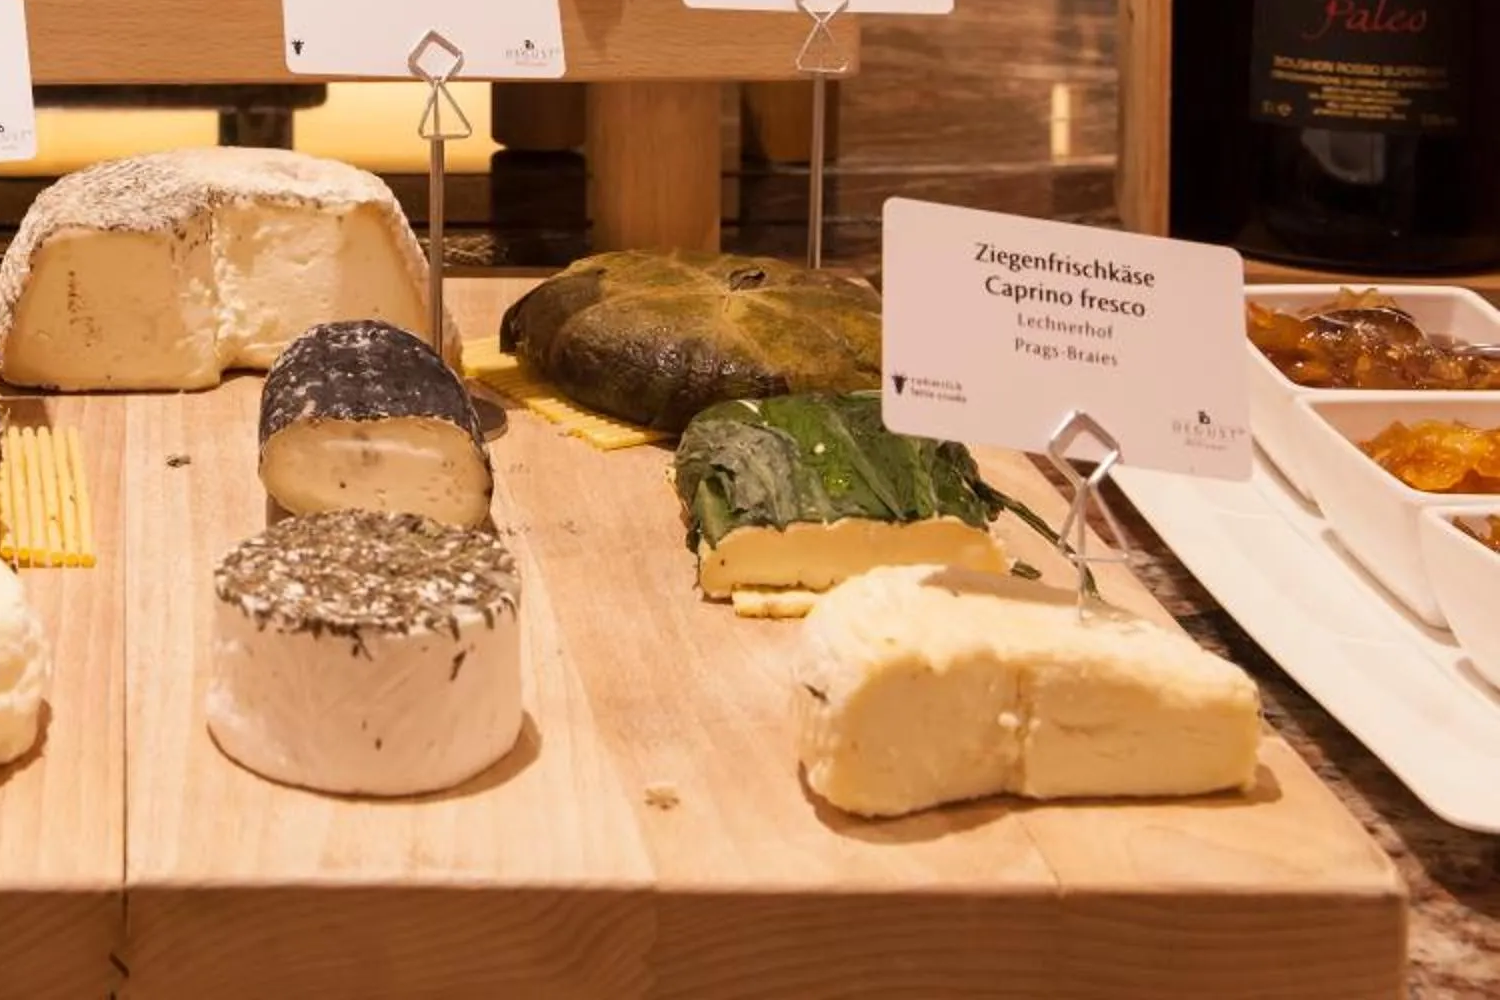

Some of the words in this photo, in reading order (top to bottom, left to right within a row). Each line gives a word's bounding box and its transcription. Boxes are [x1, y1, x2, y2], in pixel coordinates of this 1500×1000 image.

[973, 242, 1155, 288] Ziegenfrischkäse
[986, 275, 1073, 307] Caprino
[1081, 288, 1146, 318] fresco
[1018, 312, 1114, 339] Lechnerhof
[1015, 337, 1118, 366] Prags-Braies
